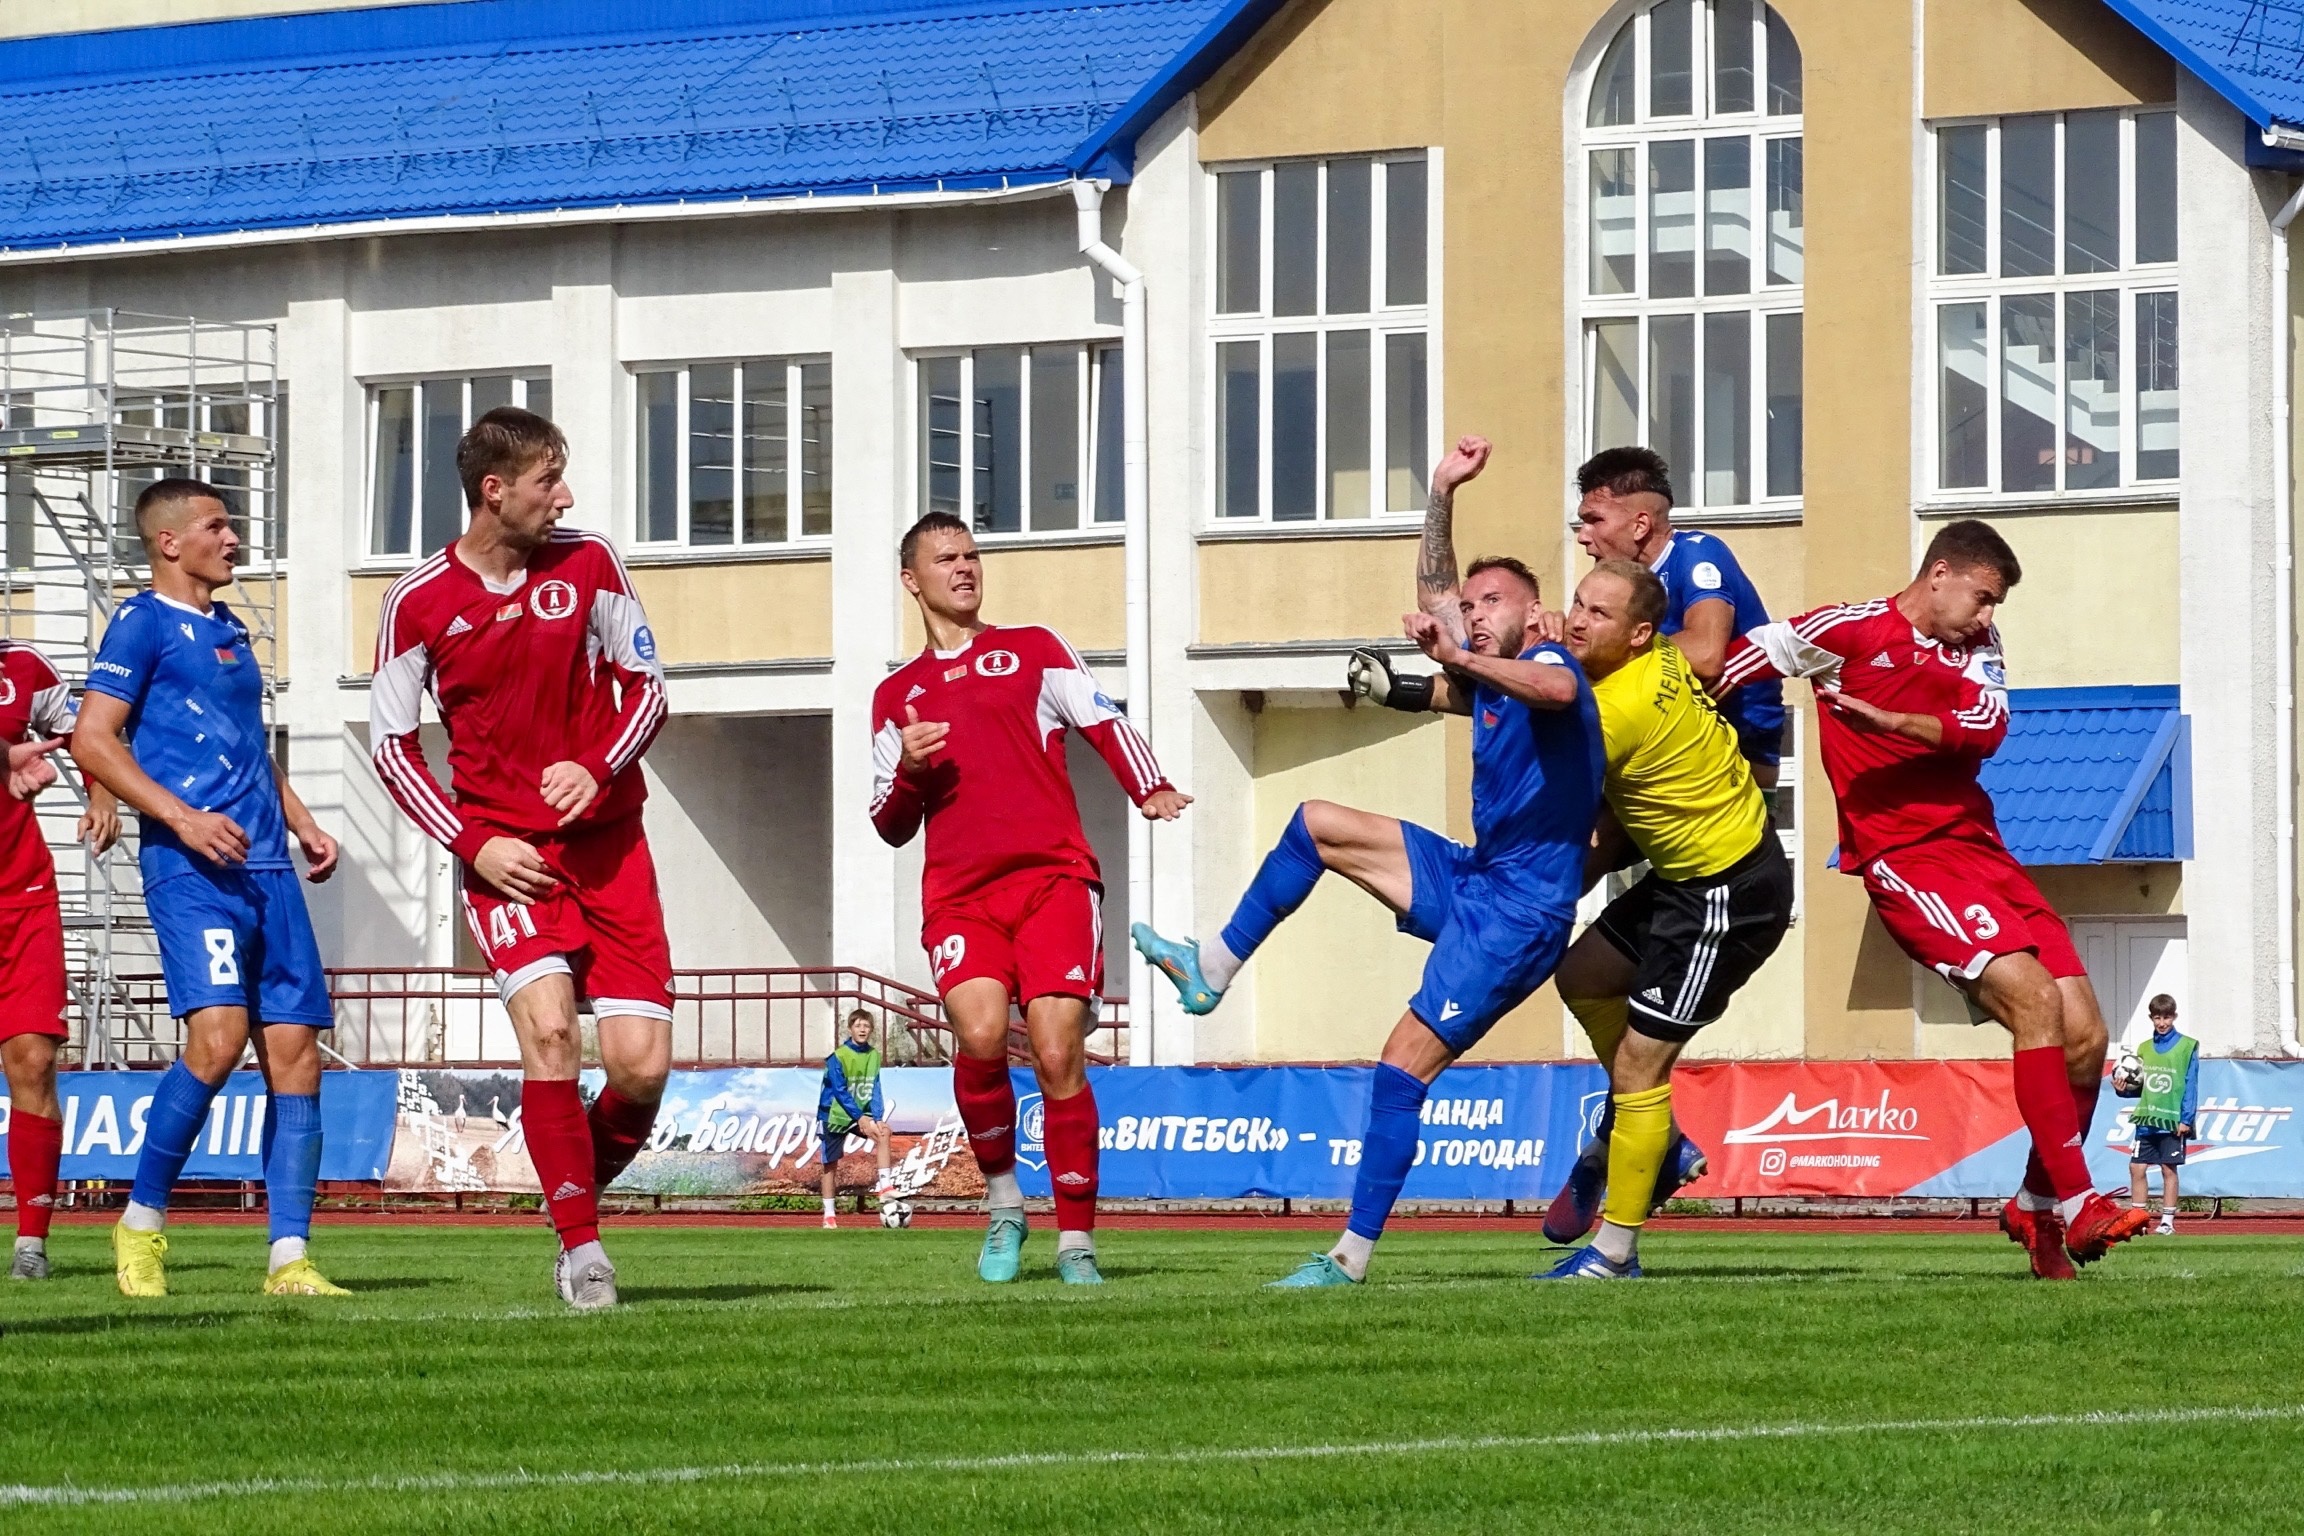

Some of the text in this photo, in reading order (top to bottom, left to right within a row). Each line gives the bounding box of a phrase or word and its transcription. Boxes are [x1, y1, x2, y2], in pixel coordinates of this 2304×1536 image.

[446, 623, 474, 637] adidas
[1870, 659, 1896, 669] adidas
[490, 903, 538, 950] 41
[1964, 903, 2000, 940] 3
[203, 928, 240, 986] 8
[932, 934, 966, 984] 29
[1098, 1116, 1290, 1152] «ВИТЕБСК»
[1723, 1088, 1920, 1144] Marko
[1431, 1139, 1545, 1171] ГОРОДА!
[1789, 1154, 1881, 1169] @MARKOHOLDING
[552, 1187, 587, 1201] adidas
